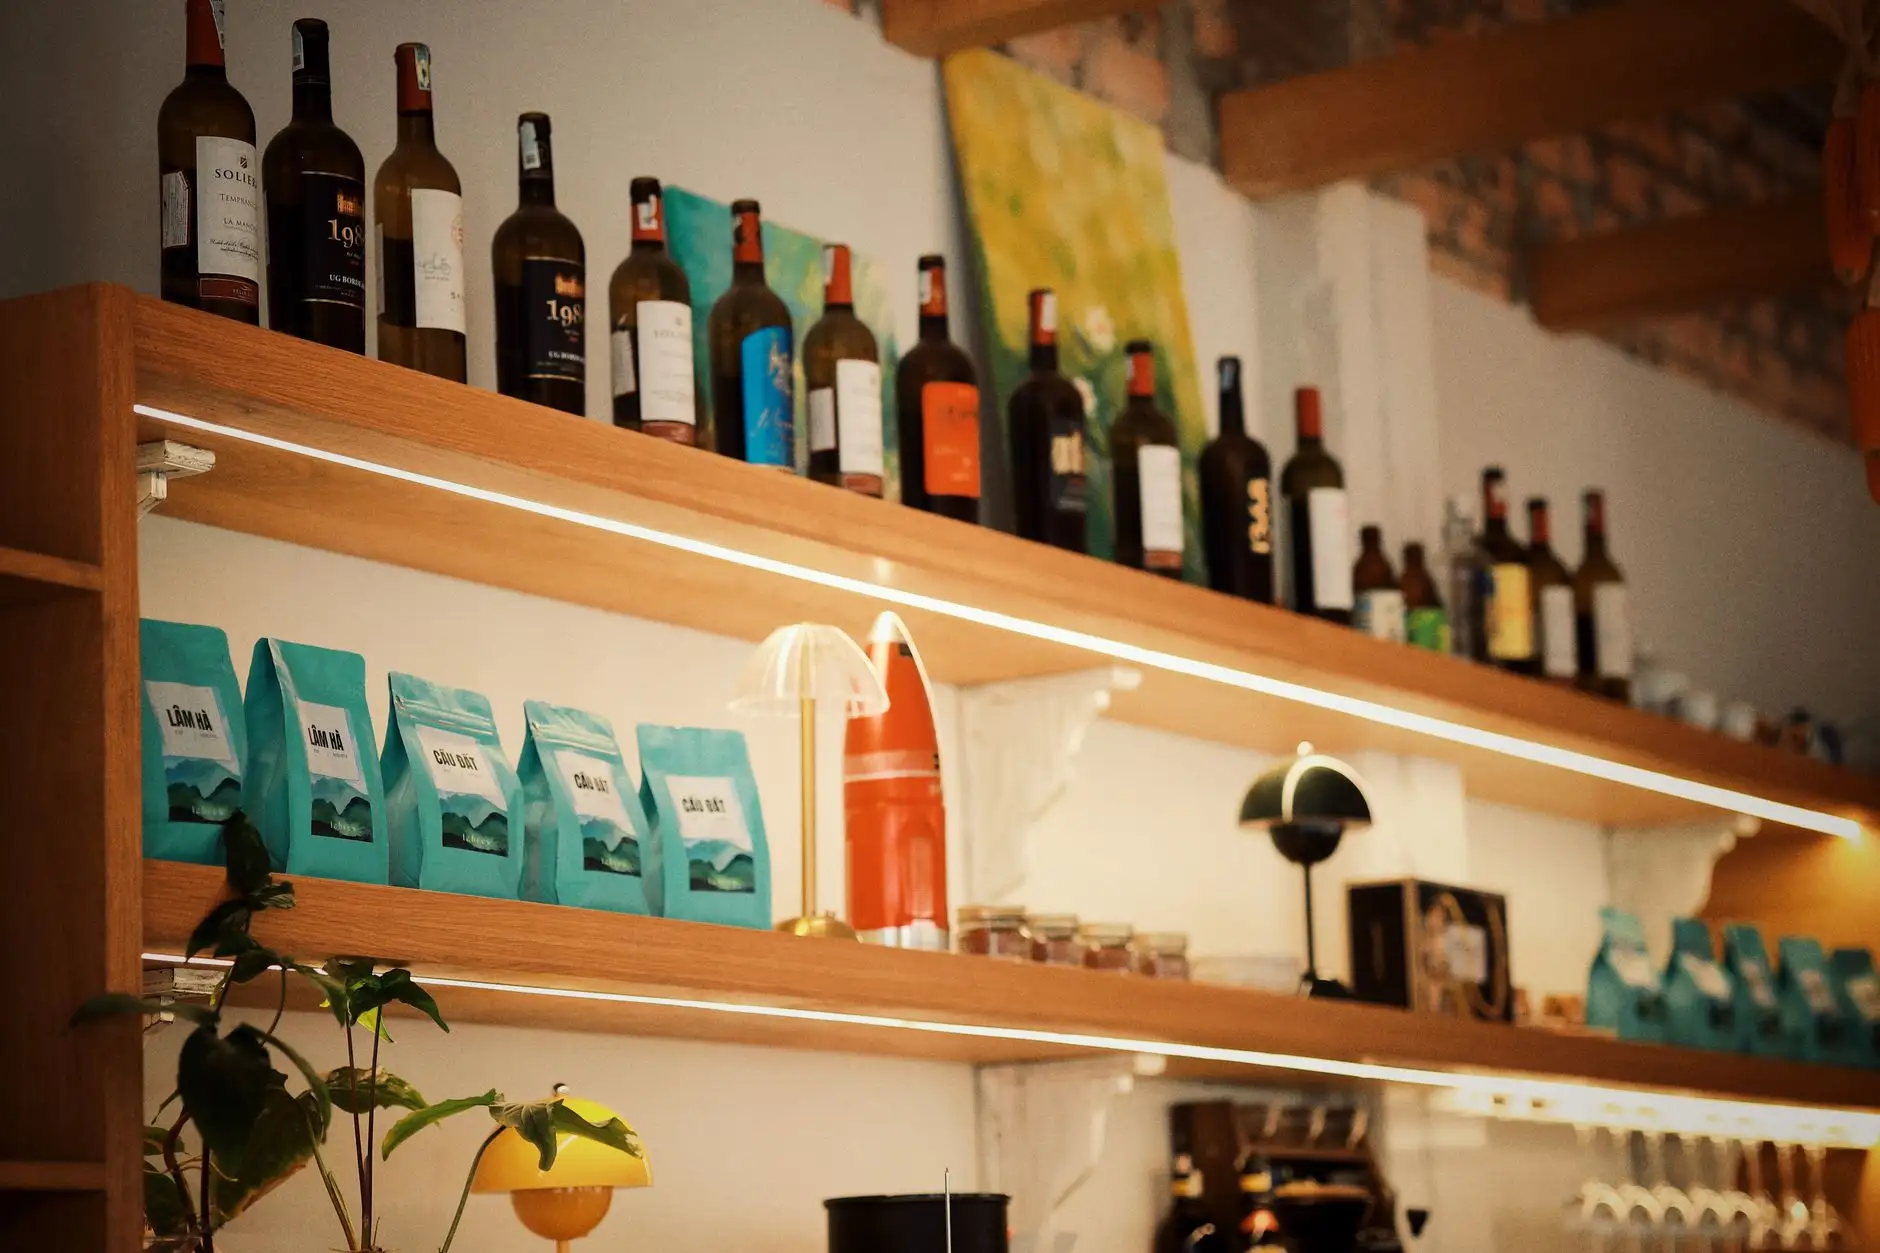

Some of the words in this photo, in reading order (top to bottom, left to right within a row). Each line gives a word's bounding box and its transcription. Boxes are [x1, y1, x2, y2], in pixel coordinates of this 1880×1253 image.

[166, 704, 196, 728] LÂM
[195, 709, 213, 731] HÀ
[307, 724, 329, 748] LÂM
[329, 728, 345, 751] HÀ
